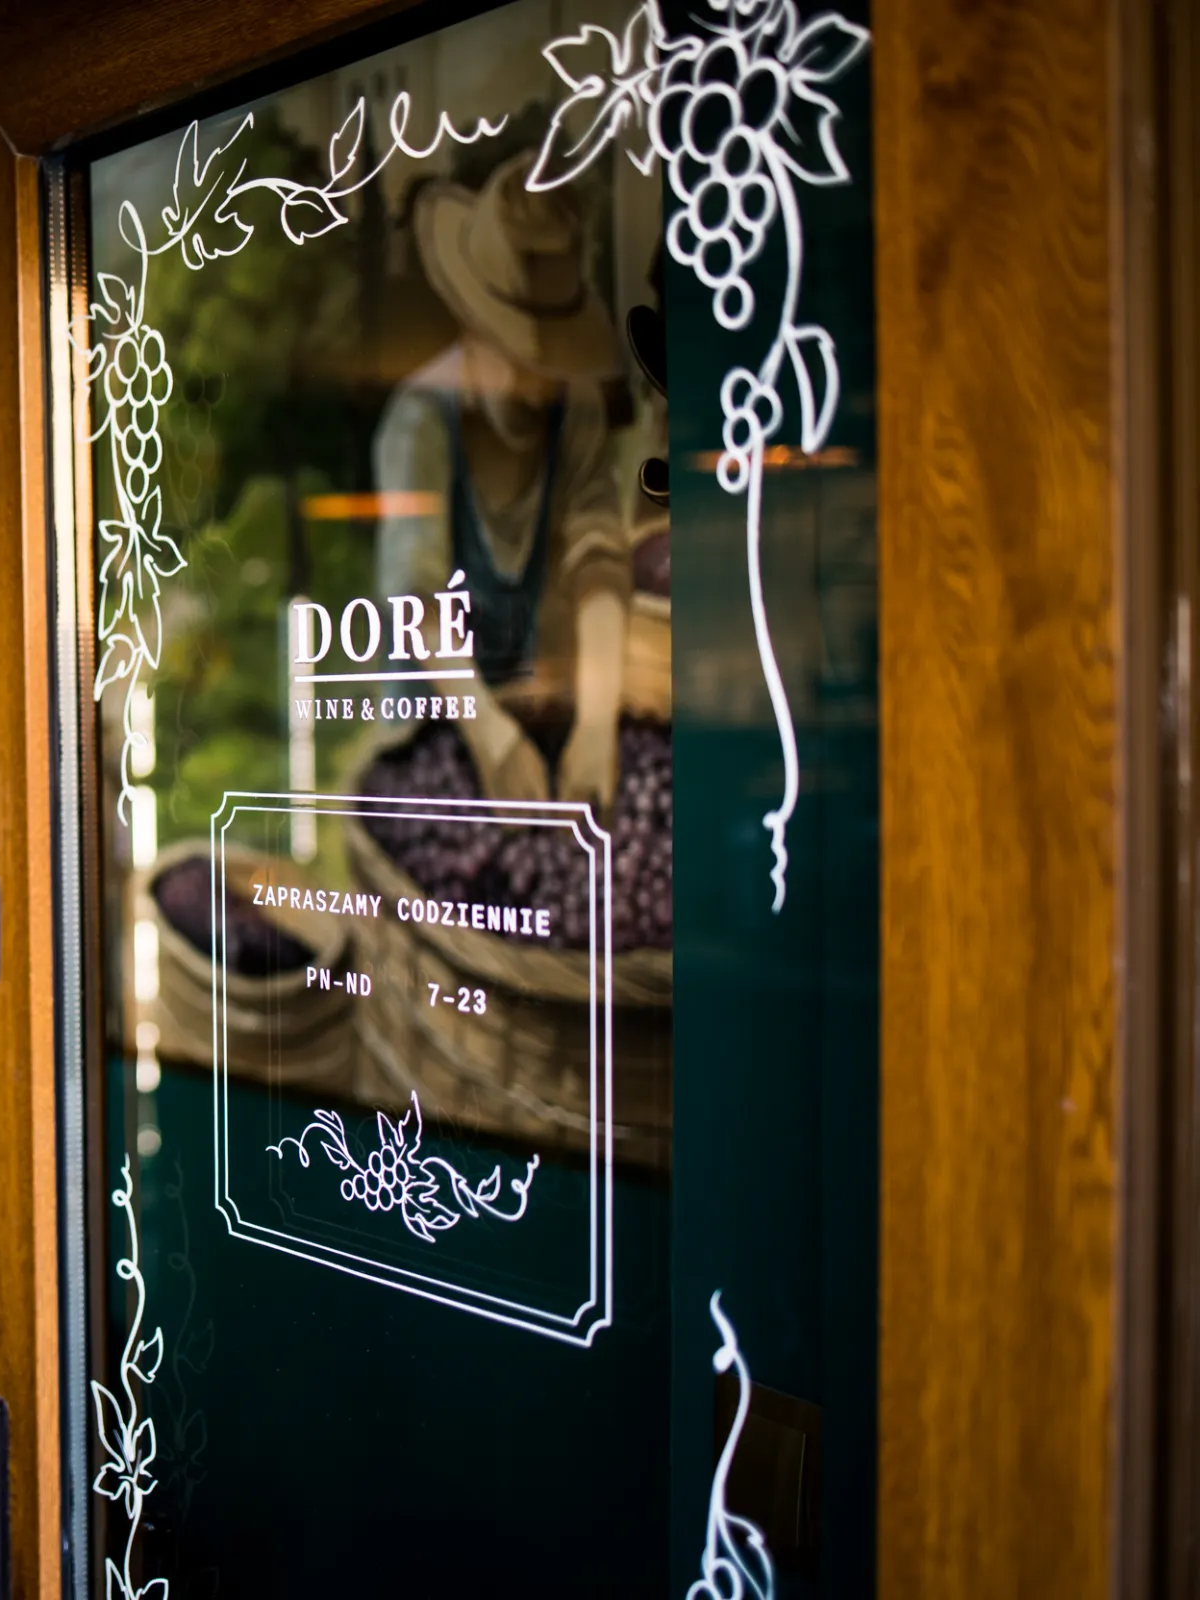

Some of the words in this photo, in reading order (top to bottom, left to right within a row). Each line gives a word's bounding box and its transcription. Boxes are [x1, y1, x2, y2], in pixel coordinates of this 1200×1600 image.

[293, 569, 474, 663] DORÉ
[294, 698, 354, 720] WINE
[361, 698, 375, 721] &
[381, 696, 477, 720] COFFEE
[252, 884, 381, 918] ZAPRASZAMY
[397, 897, 551, 937] CODZIENNIE
[306, 966, 372, 997] PN-ND
[427, 983, 487, 1015] 7-23
